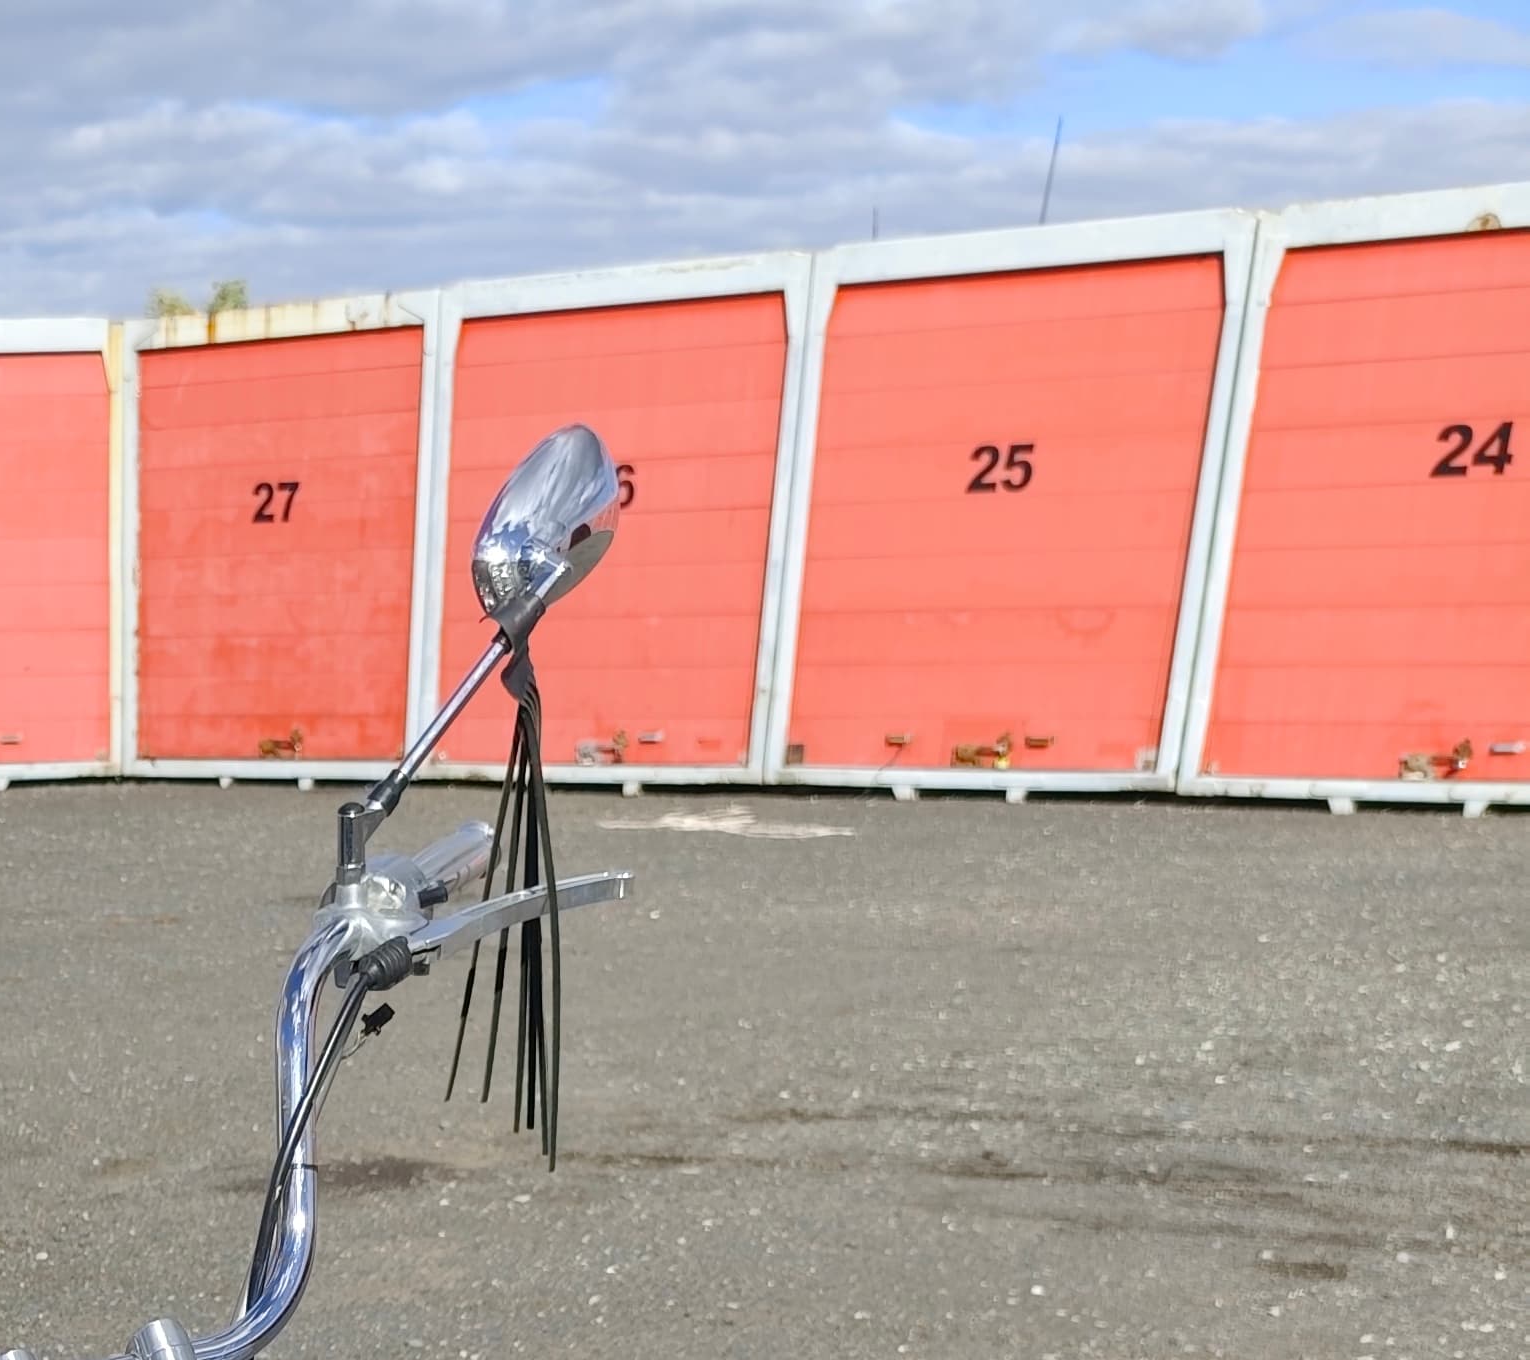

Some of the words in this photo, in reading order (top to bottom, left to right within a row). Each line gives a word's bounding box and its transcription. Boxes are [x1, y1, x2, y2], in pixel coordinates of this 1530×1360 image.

[966, 444, 1035, 494] 25
[1431, 422, 1513, 478] 24
[252, 481, 299, 524] 27
[615, 464, 635, 510] 6
